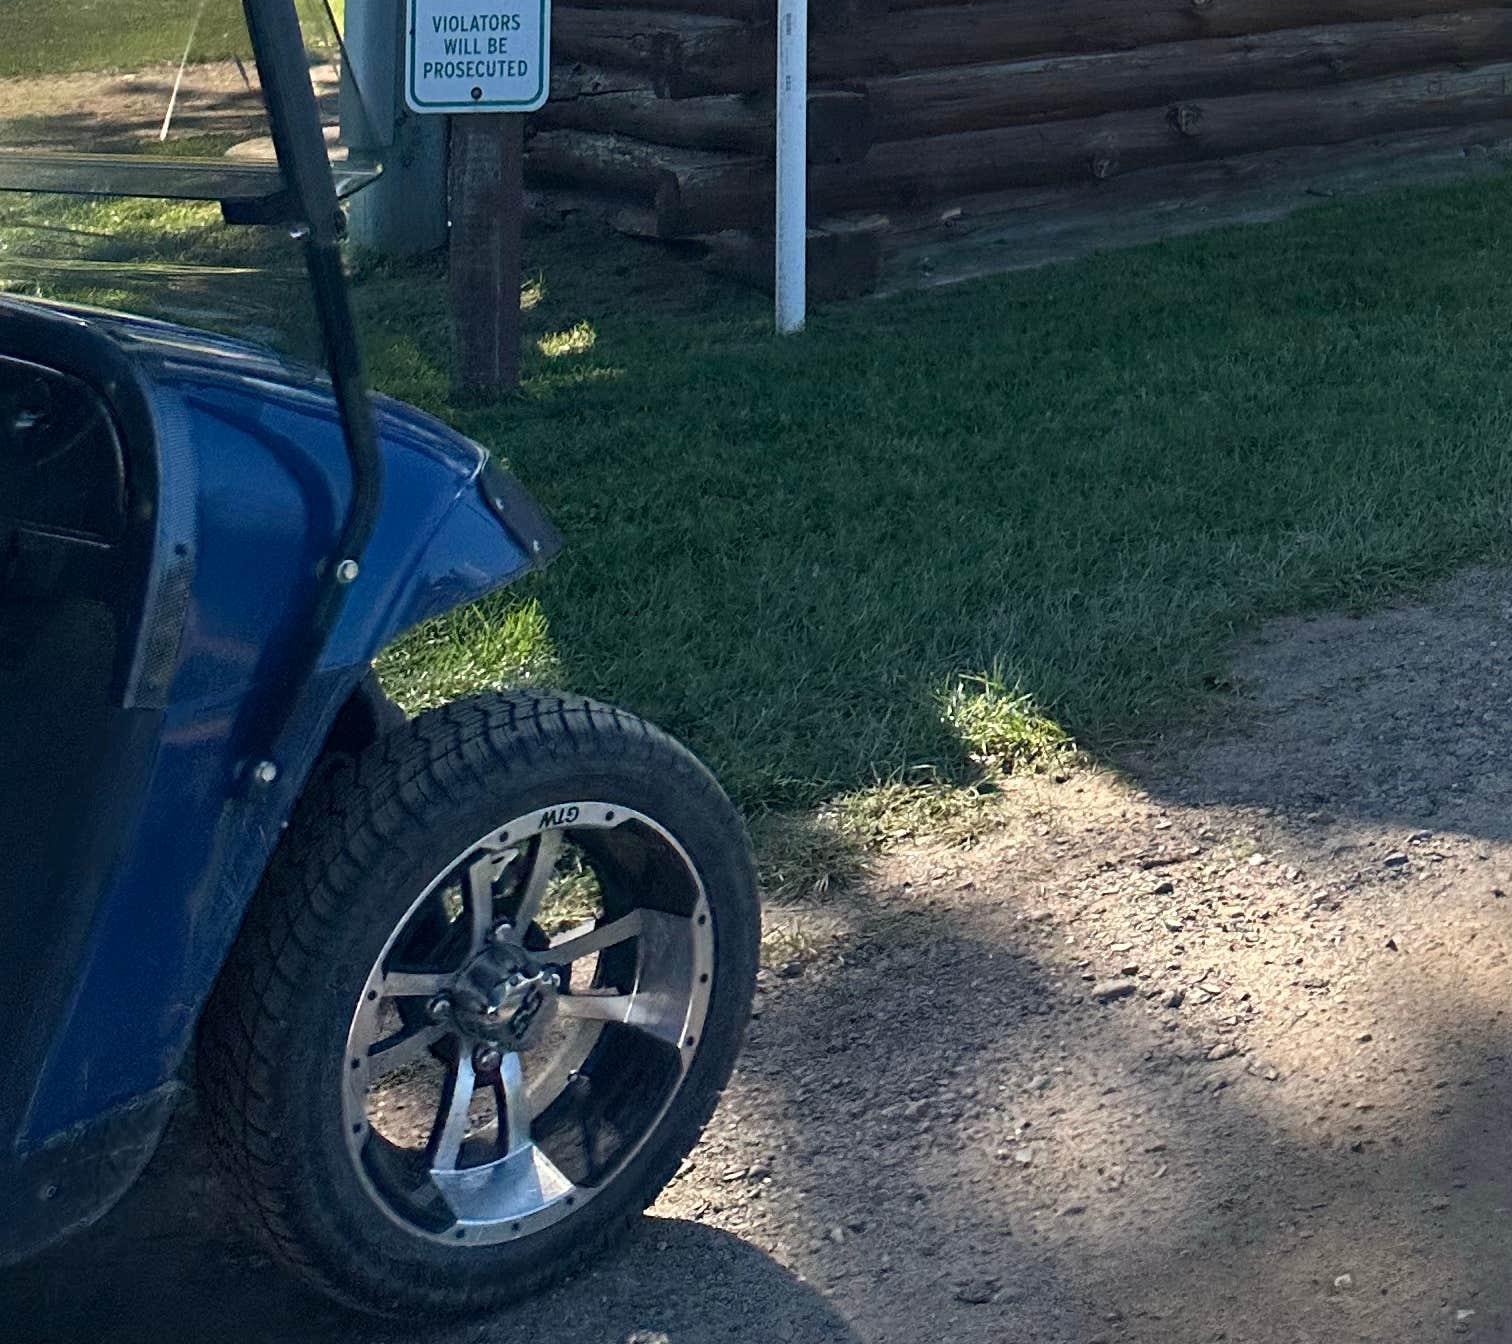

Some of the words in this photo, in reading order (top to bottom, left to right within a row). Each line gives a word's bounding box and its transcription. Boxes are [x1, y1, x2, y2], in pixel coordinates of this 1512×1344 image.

[432, 15, 520, 32] VIOLATORS
[444, 39, 481, 55] WILL
[488, 38, 507, 54] BE
[423, 61, 527, 79] PROSECUTED
[538, 806, 579, 829] GTW
